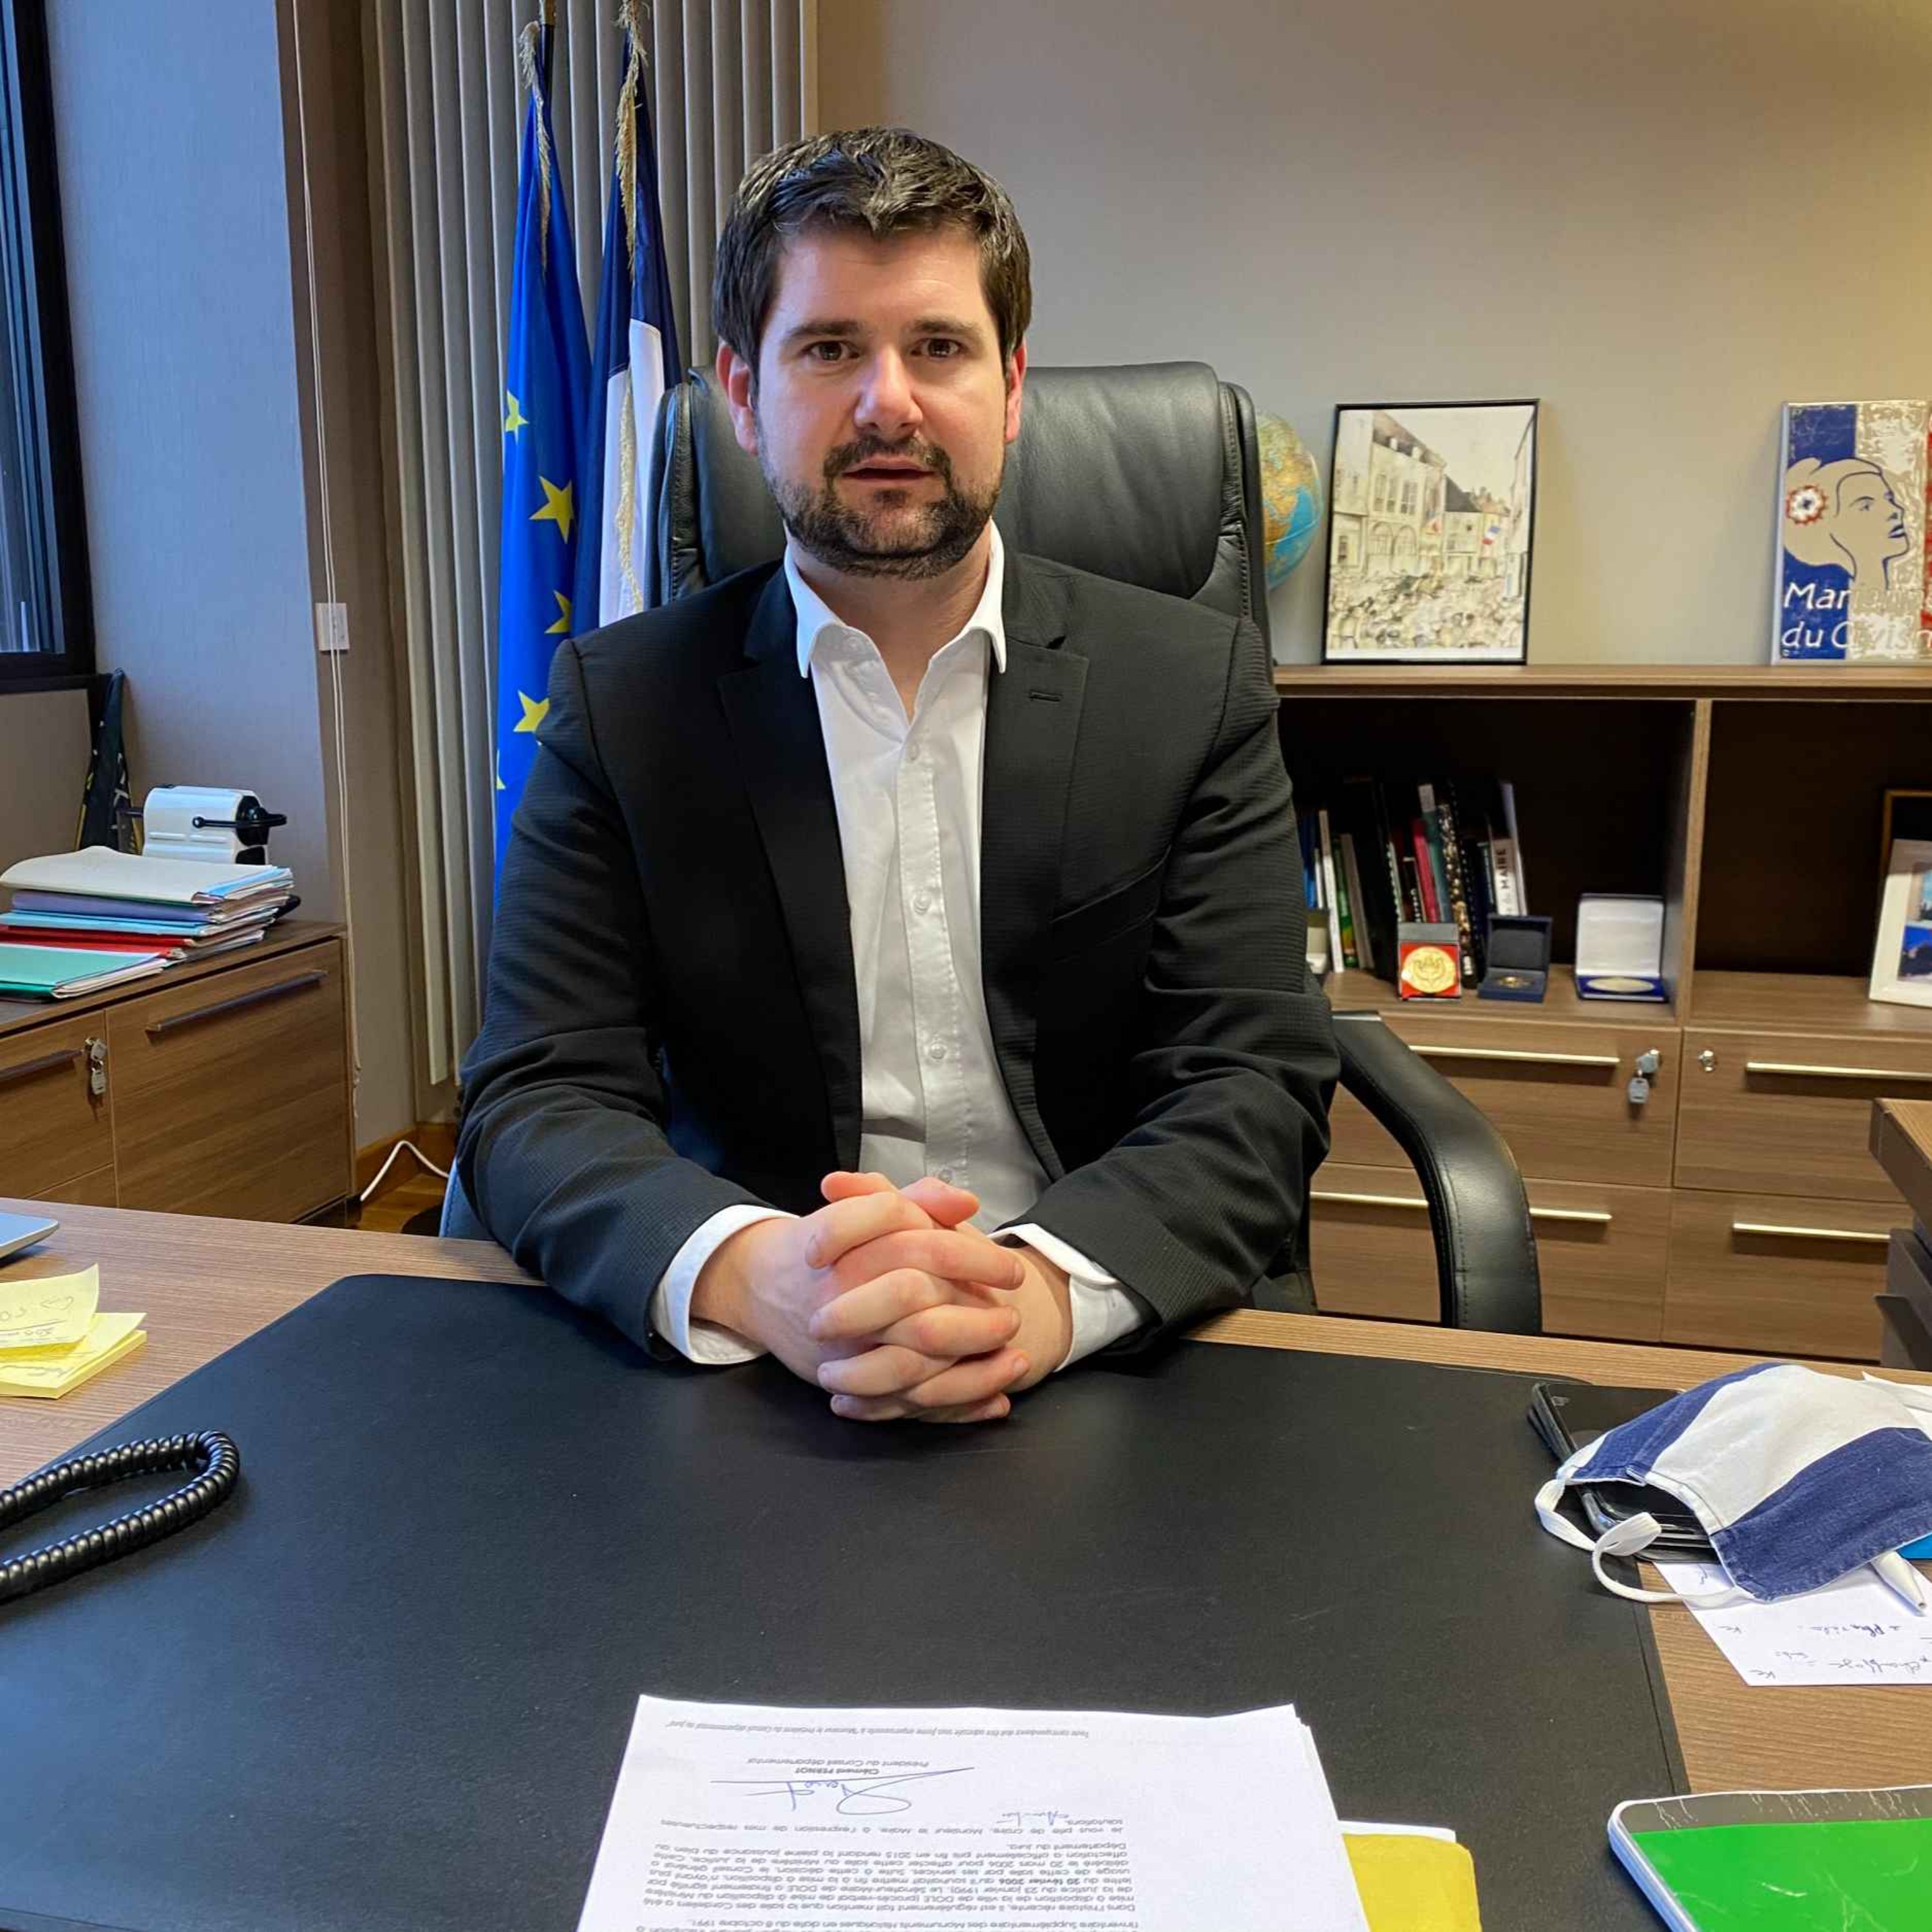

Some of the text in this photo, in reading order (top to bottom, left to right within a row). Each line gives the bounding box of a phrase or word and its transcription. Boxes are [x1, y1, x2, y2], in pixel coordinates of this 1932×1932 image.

[1781, 621, 1824, 648] du
[746, 1757, 825, 1766] départemental
[882, 1760, 929, 1769] Président
[836, 1767, 880, 1776] Clément
[1054, 1842, 1126, 1850] Département
[654, 1853, 685, 1862] Cette
[711, 1884, 772, 1892] finalement
